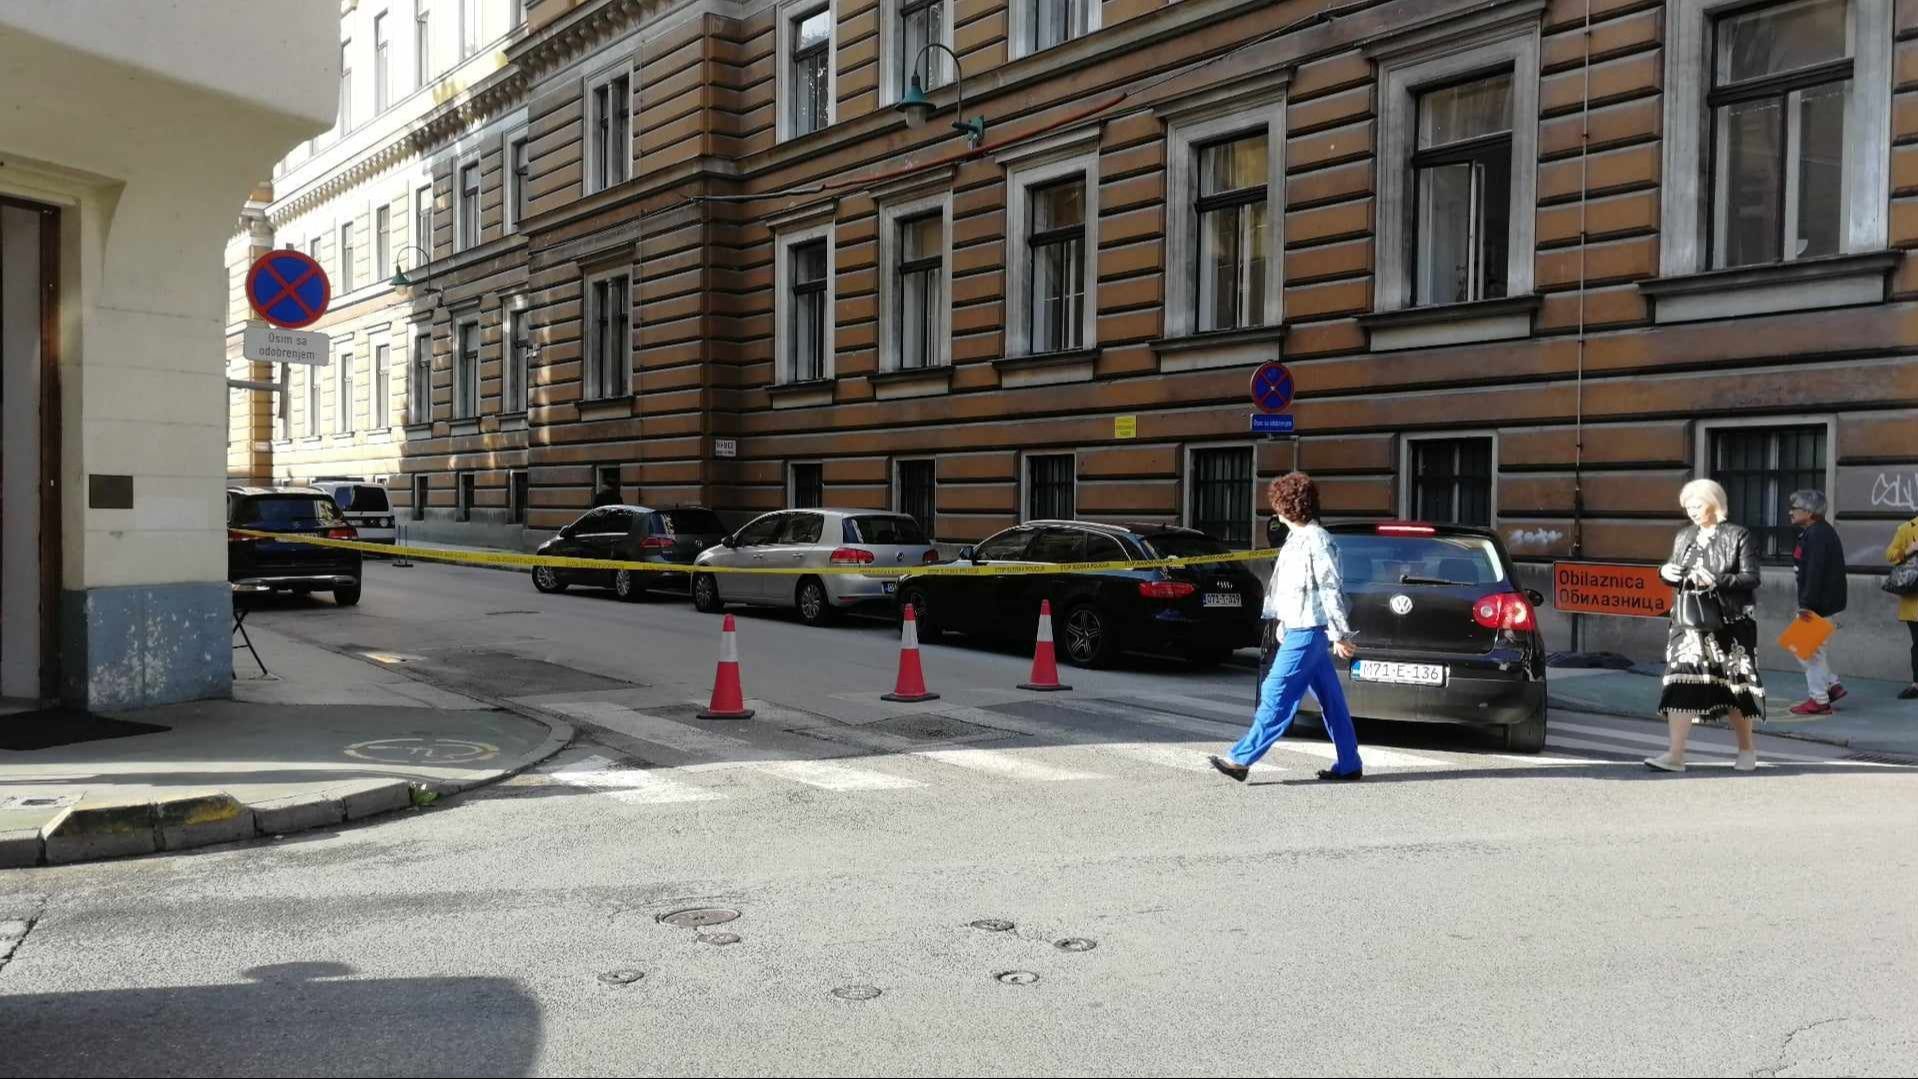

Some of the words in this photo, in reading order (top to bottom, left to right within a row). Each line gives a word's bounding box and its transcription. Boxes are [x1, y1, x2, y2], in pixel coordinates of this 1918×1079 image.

[268, 332, 293, 345] Osim
[296, 337, 308, 346] sa
[258, 344, 315, 360] odobrenjem
[1559, 569, 1645, 590] Obilaznica
[1559, 588, 1665, 611] Обилазница
